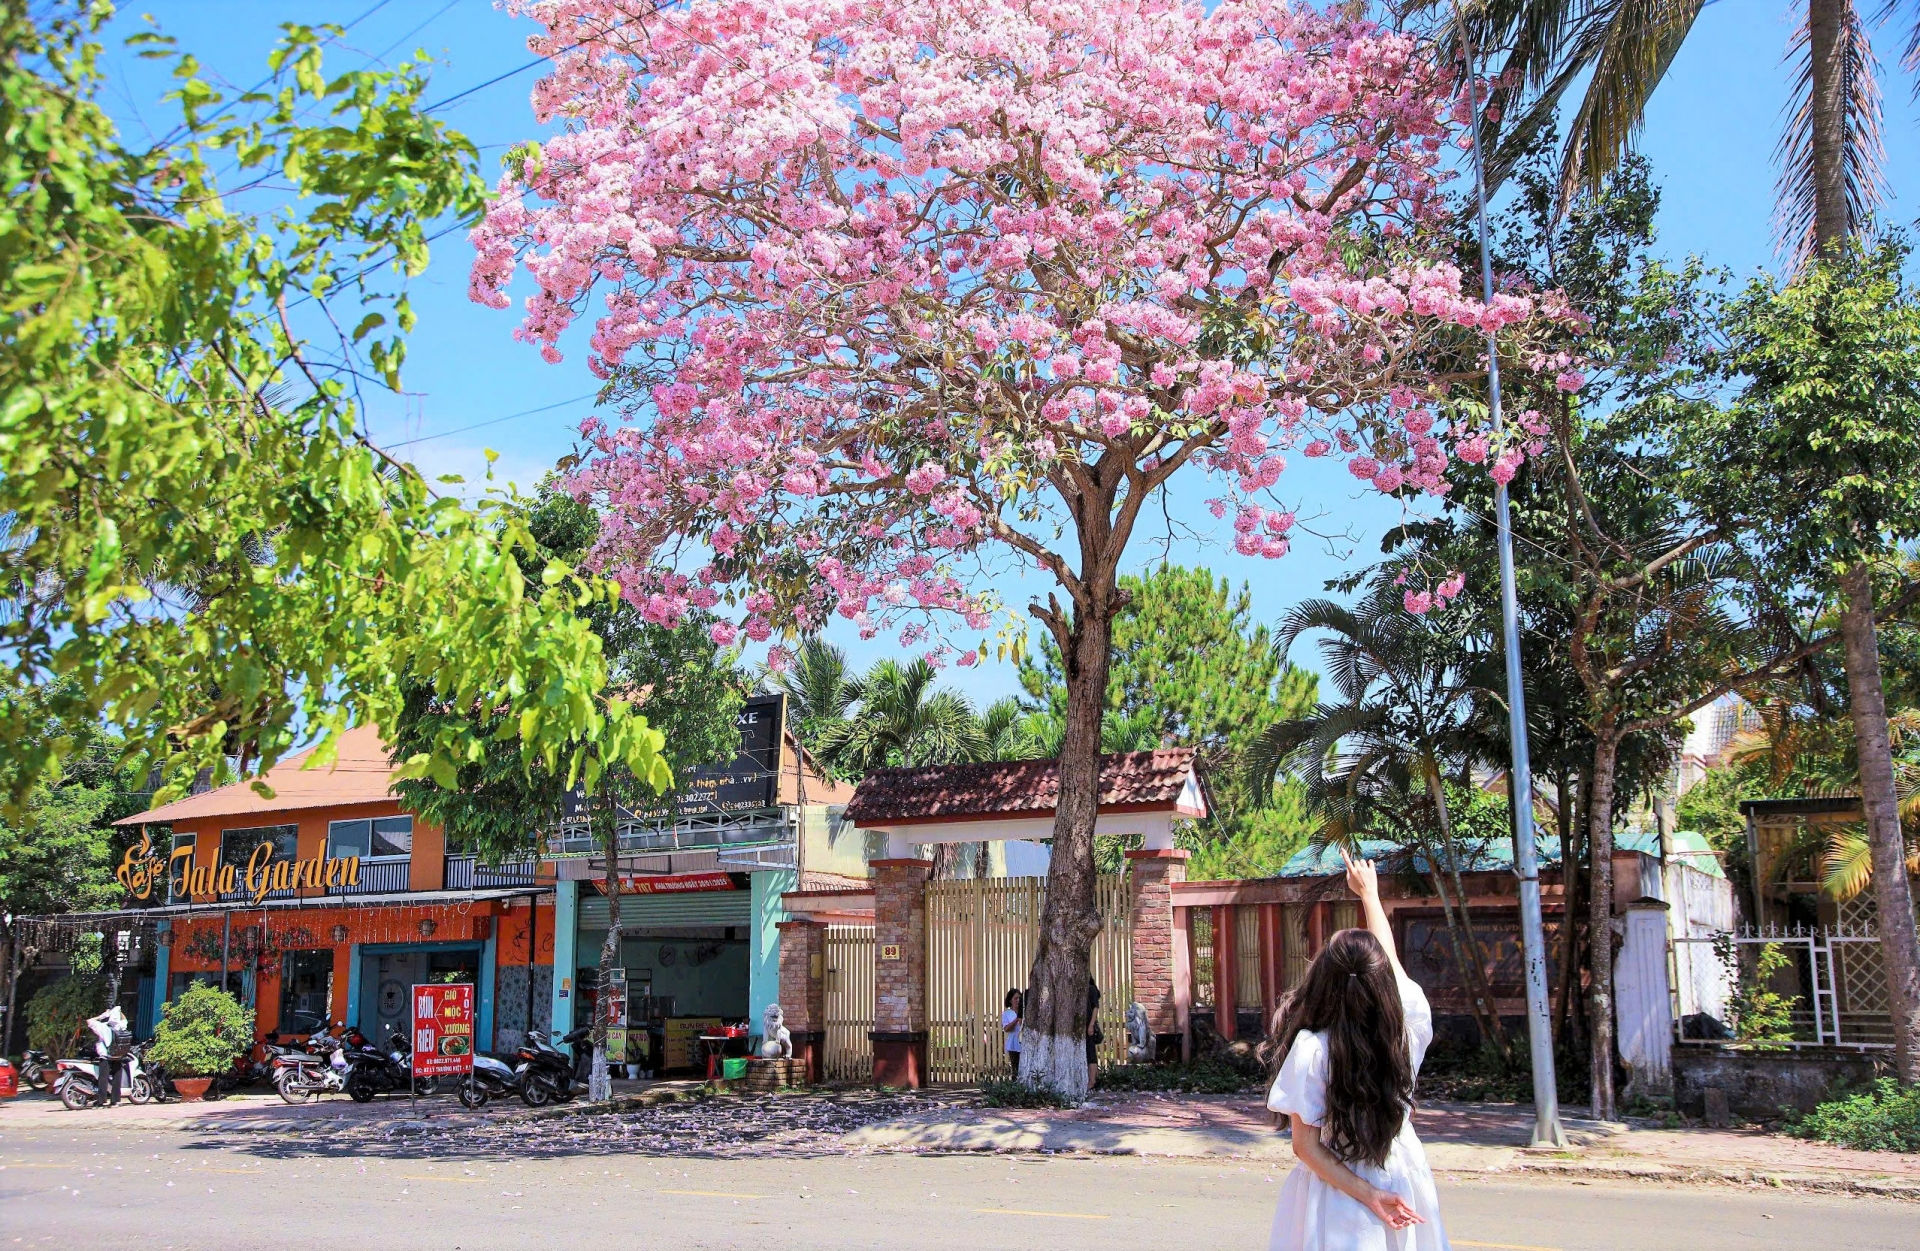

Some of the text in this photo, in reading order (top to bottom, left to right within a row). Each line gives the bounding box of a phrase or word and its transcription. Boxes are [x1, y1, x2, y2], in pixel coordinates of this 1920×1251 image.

[736, 712, 759, 726] XE
[170, 845, 238, 898] Tala
[246, 838, 361, 905] Garden
[885, 946, 897, 956] 89
[444, 1005, 461, 1019] MỘC
[417, 990, 434, 1053] BÚN RIÊU
[444, 1023, 470, 1034] XƯƠNG
